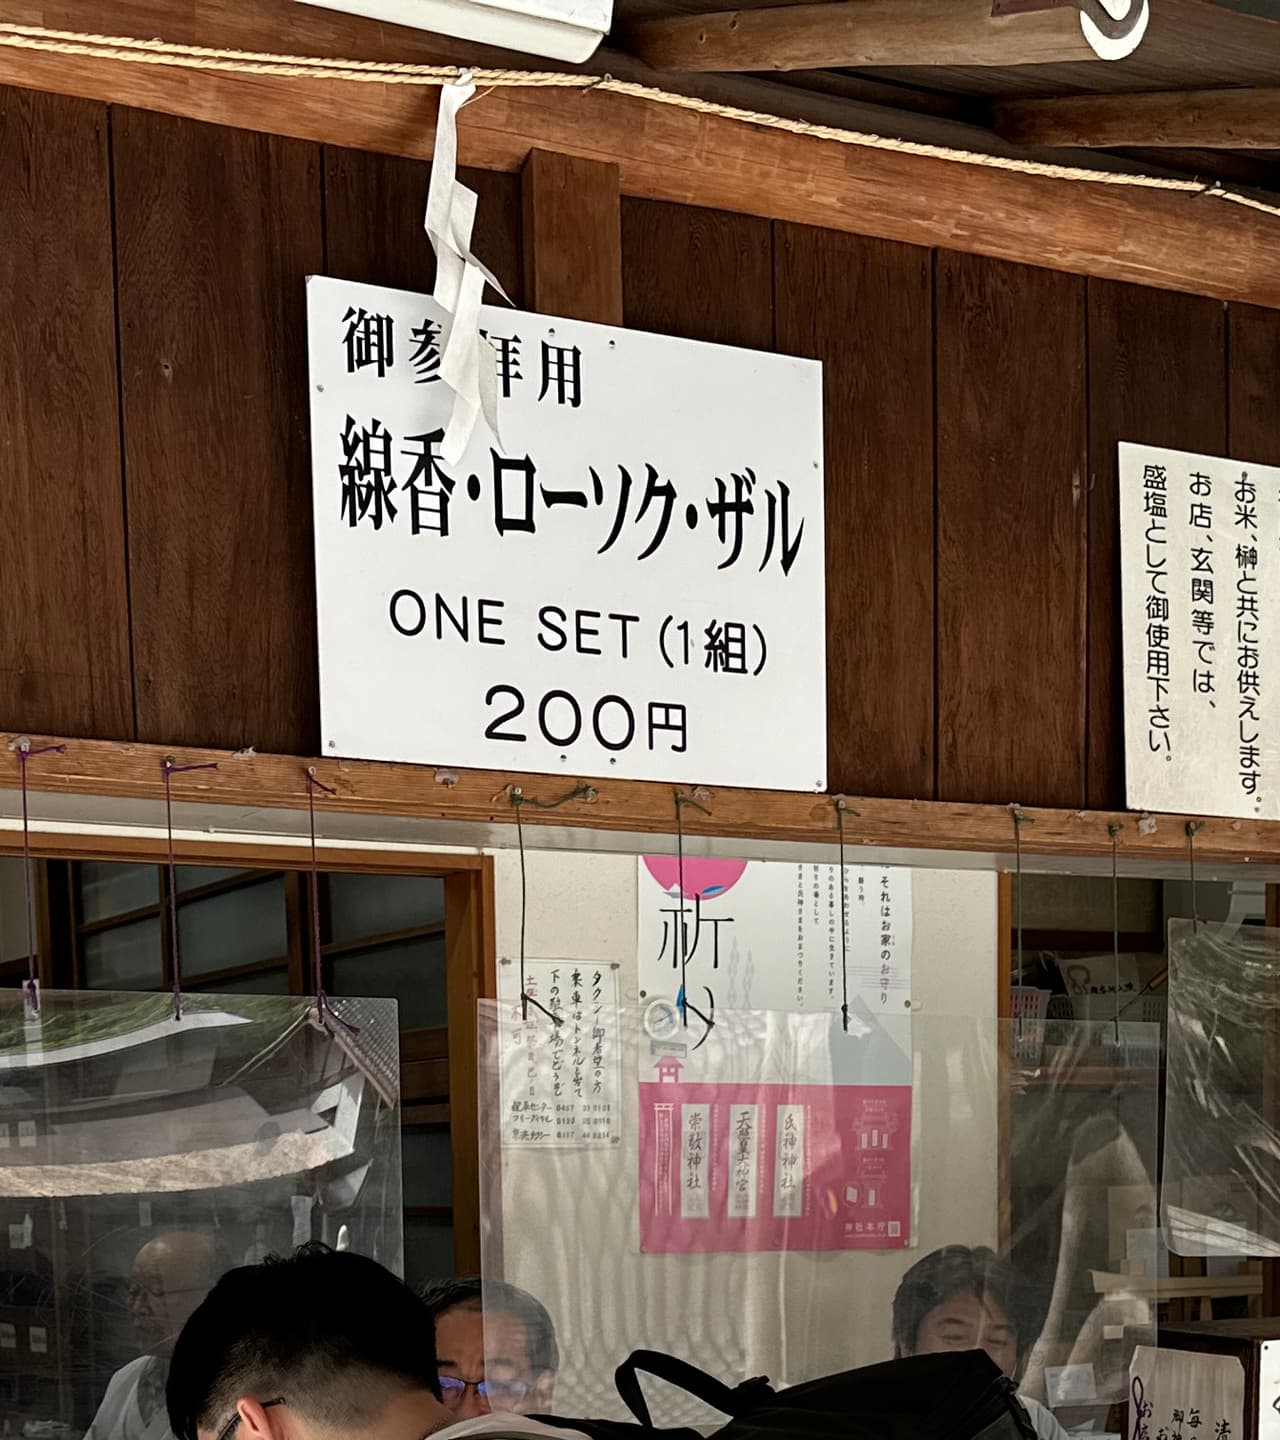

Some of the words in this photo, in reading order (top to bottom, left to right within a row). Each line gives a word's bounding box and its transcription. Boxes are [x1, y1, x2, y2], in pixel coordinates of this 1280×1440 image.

[390, 590, 505, 645] ONE
[537, 606, 639, 659] SET
[659, 616, 767, 676] (1組)
[1143, 465, 1172, 762] 盛塩として御使用下さい。
[1189, 471, 1217, 709] お店、玄関等では、
[1234, 480, 1262, 803] お米、榊と共にお供えします。
[485, 684, 687, 753] 200円
[880, 865, 891, 1005] それはお家のお守り
